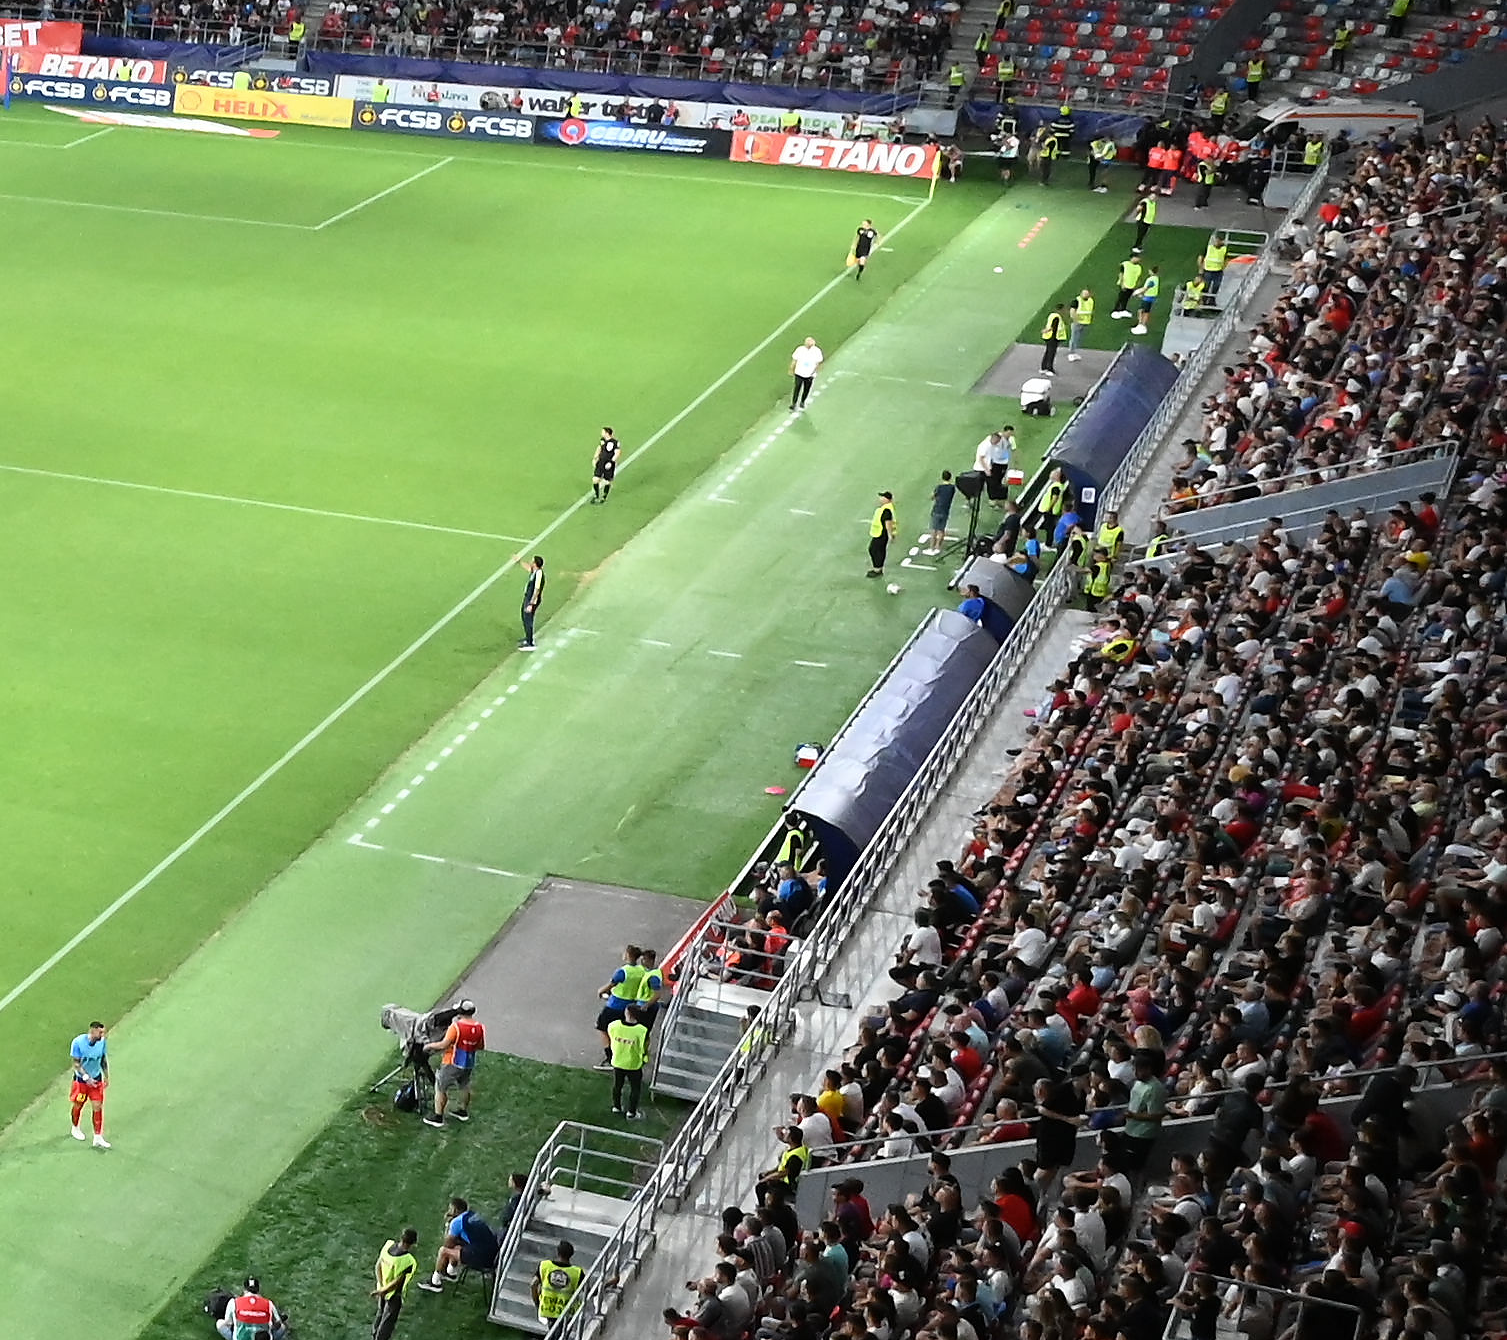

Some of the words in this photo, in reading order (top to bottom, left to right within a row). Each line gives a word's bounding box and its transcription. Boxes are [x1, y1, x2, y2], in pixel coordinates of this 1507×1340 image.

[25, 80, 86, 100] FCSB
[109, 86, 172, 107] FCSB
[213, 97, 290, 121] HELIX
[379, 108, 442, 130] FCSB
[467, 115, 532, 138] FCSB
[779, 136, 926, 176] BETANO
